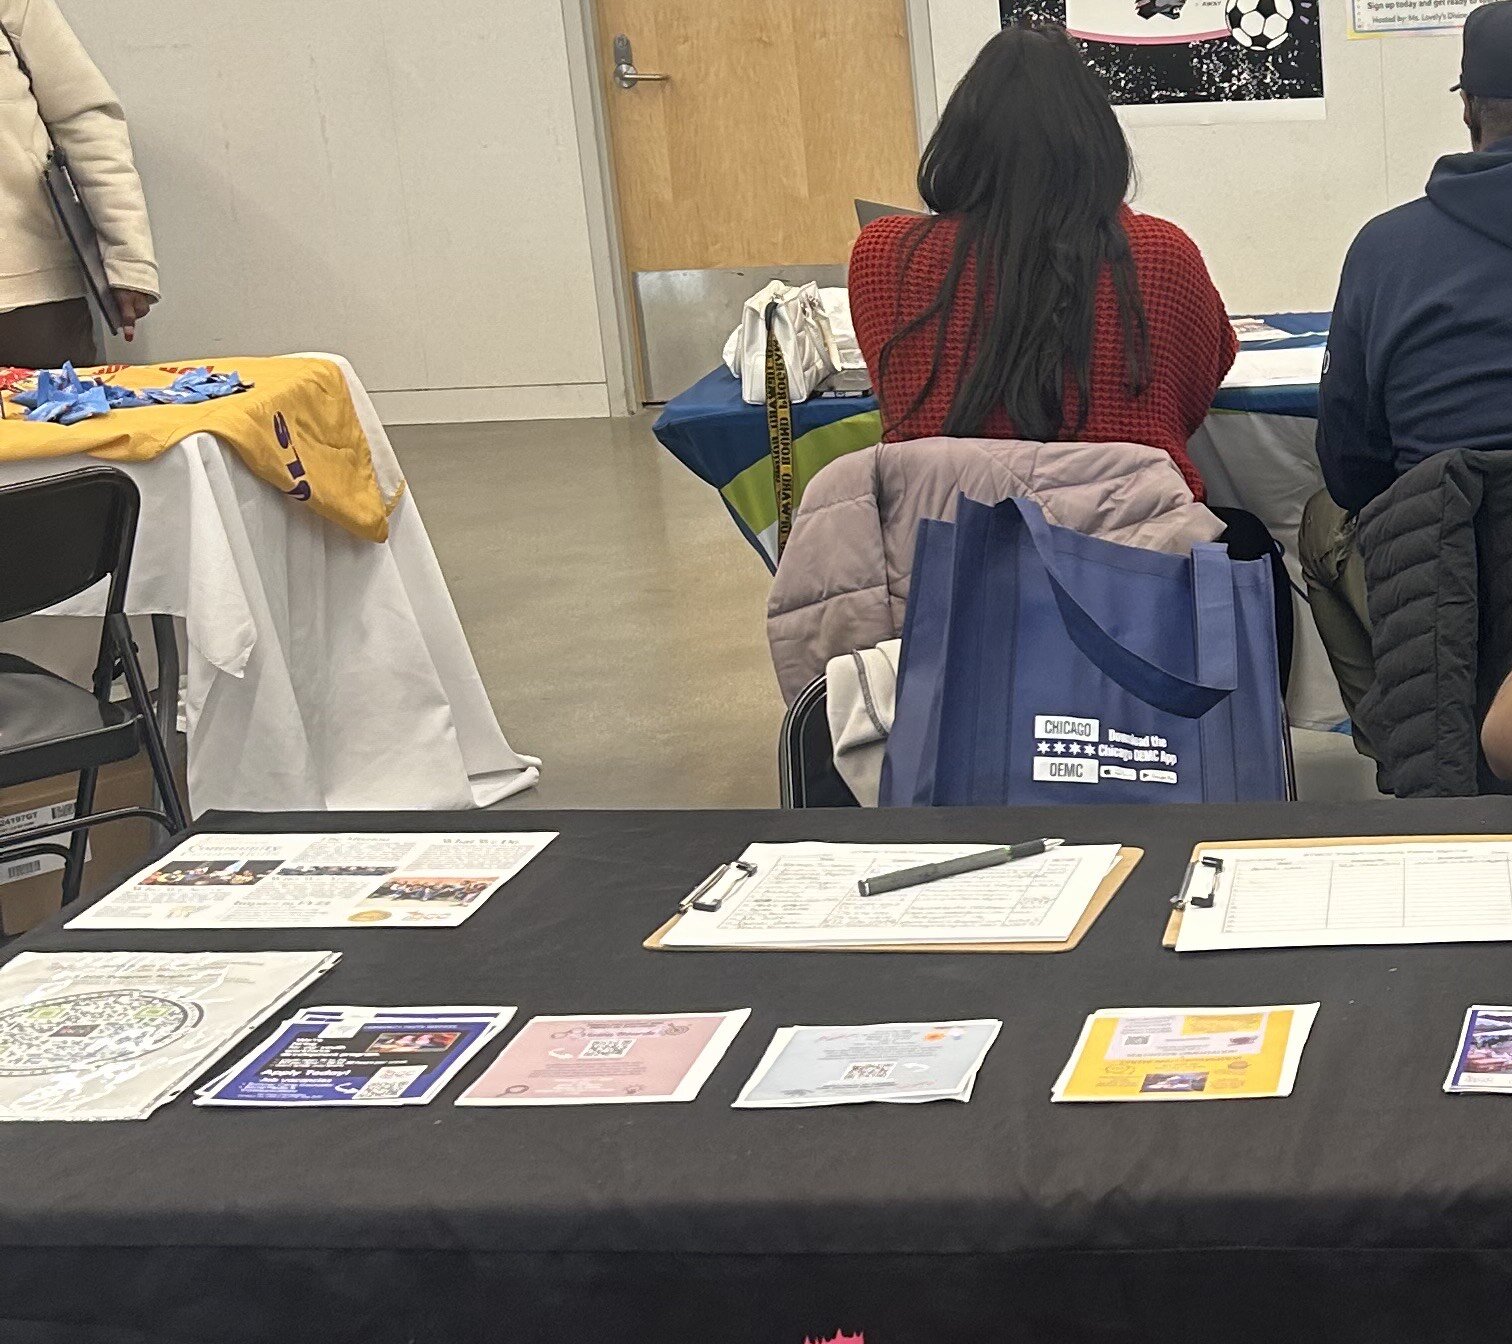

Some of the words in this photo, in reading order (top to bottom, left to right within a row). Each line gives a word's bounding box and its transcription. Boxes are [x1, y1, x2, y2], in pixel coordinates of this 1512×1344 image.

[1045, 720, 1091, 736] CHICAGO
[1150, 735, 1167, 748] the
[1098, 744, 1133, 761] Chicago
[1050, 762, 1083, 778] OEMC
[260, 1069, 301, 1077] Apply
[305, 1069, 351, 1077] Today!
